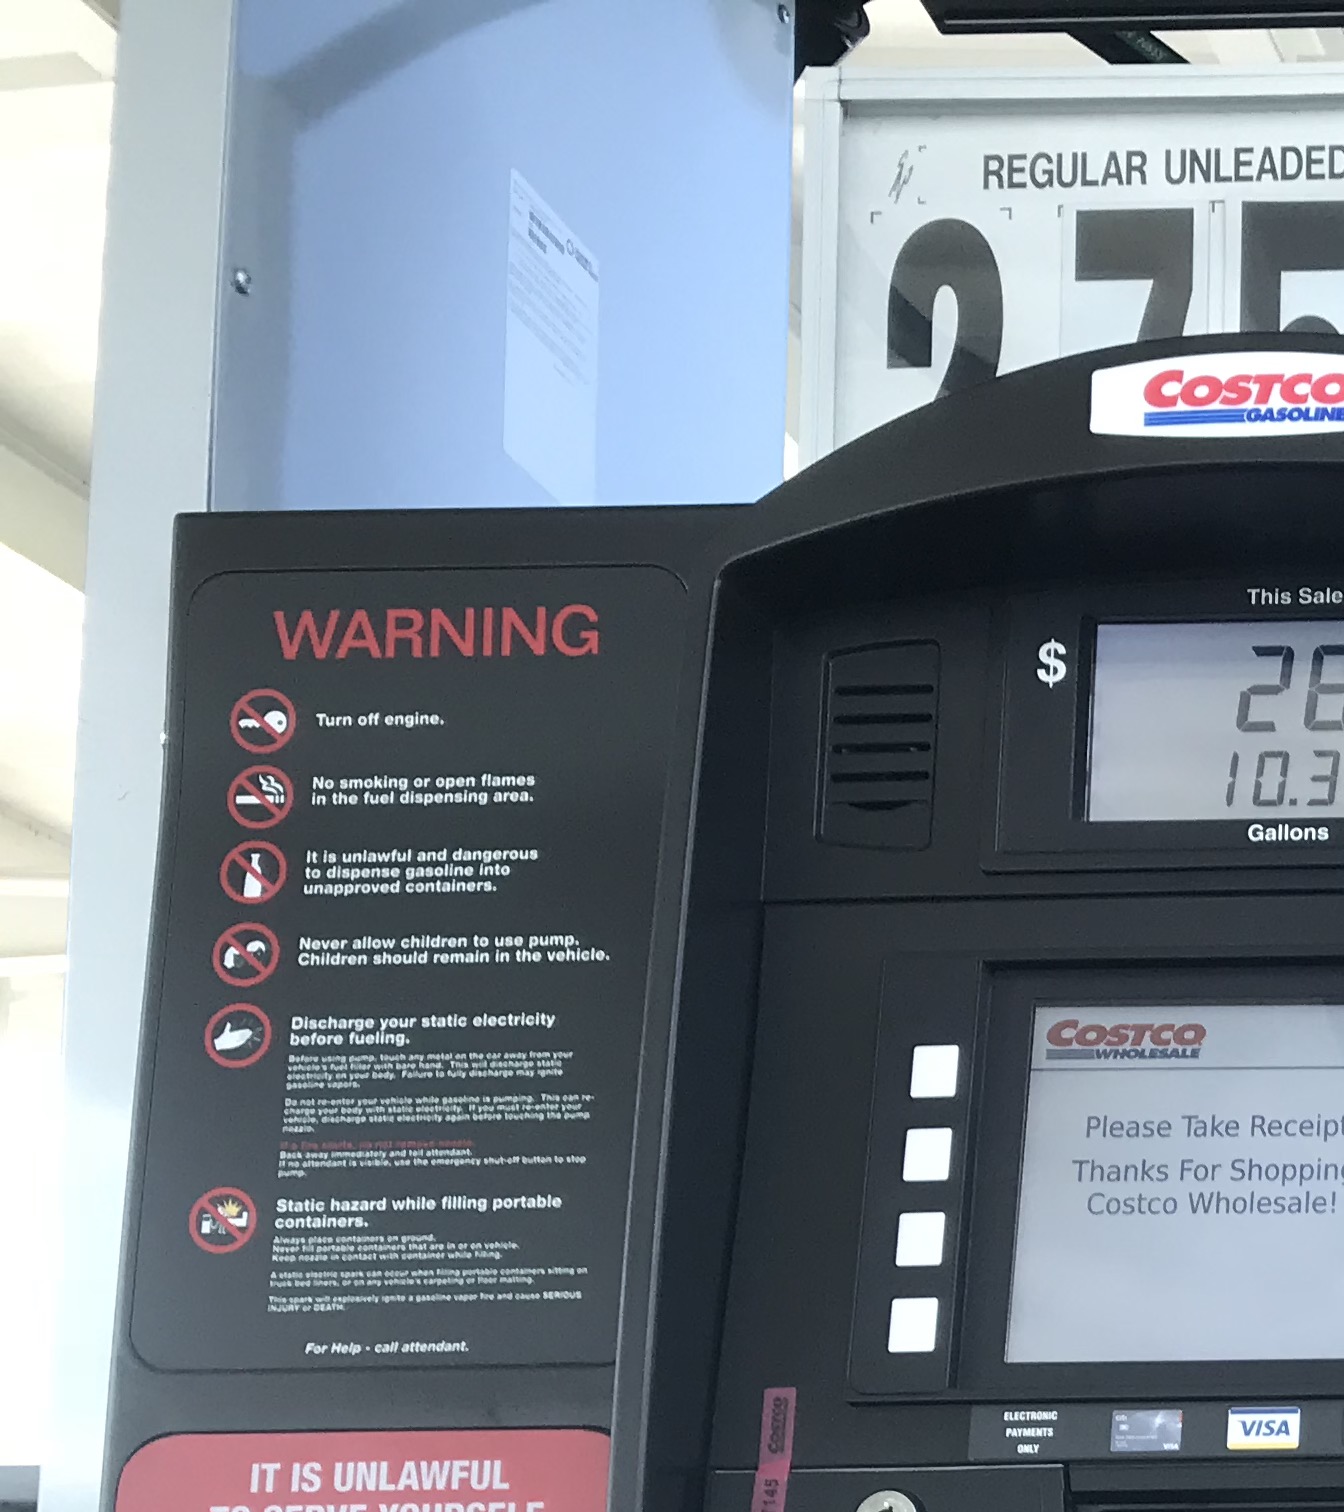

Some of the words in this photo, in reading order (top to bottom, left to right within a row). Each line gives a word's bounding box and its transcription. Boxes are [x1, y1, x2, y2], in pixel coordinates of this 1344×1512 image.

[983, 151, 1147, 190] REGULAR
[1247, 588, 1291, 605] This
[1299, 588, 1343, 605] Sale
[274, 605, 600, 659] WARNING
[1036, 638, 1067, 688] $
[316, 713, 352, 727] Turn
[358, 712, 379, 726] off
[385, 712, 444, 728] engine.
[313, 776, 334, 790] No
[340, 775, 408, 792] smoking
[412, 777, 430, 791] or
[436, 776, 475, 791] open
[481, 773, 535, 787] flames
[312, 792, 326, 806] in
[332, 791, 358, 805] the
[364, 791, 394, 804] fuel
[400, 789, 487, 806] dispensing
[493, 791, 533, 803] area.
[1248, 823, 1328, 841] Gallons
[292, 1016, 374, 1032] Discharge
[377, 1017, 417, 1033] your
[422, 1014, 467, 1028] static
[473, 1012, 555, 1028] electricity
[290, 1033, 343, 1046] before
[349, 1029, 409, 1047] fueling.
[1046, 1019, 1206, 1050] COSTCO
[1096, 1047, 1200, 1060] WHOLESALE
[1086, 1116, 1172, 1139] Please
[1182, 1114, 1239, 1138] Take
[1072, 1159, 1168, 1182] Thanks
[1180, 1159, 1221, 1182] For
[1088, 1192, 1177, 1216] Costco
[1189, 1191, 1336, 1214] Wholesale!
[305, 1342, 328, 1354] For
[331, 1342, 361, 1356] Help
[375, 1341, 399, 1354] call
[401, 1341, 468, 1352] attendant.
[1004, 1410, 1057, 1421] ELECTRONIC
[1006, 1427, 1053, 1438] PAYMENTS
[1241, 1420, 1289, 1437] VISA
[1018, 1444, 1039, 1454] ONLY
[250, 1463, 281, 1493] IT
[291, 1461, 321, 1492] IS
[334, 1460, 509, 1492] UNLAWFUL
